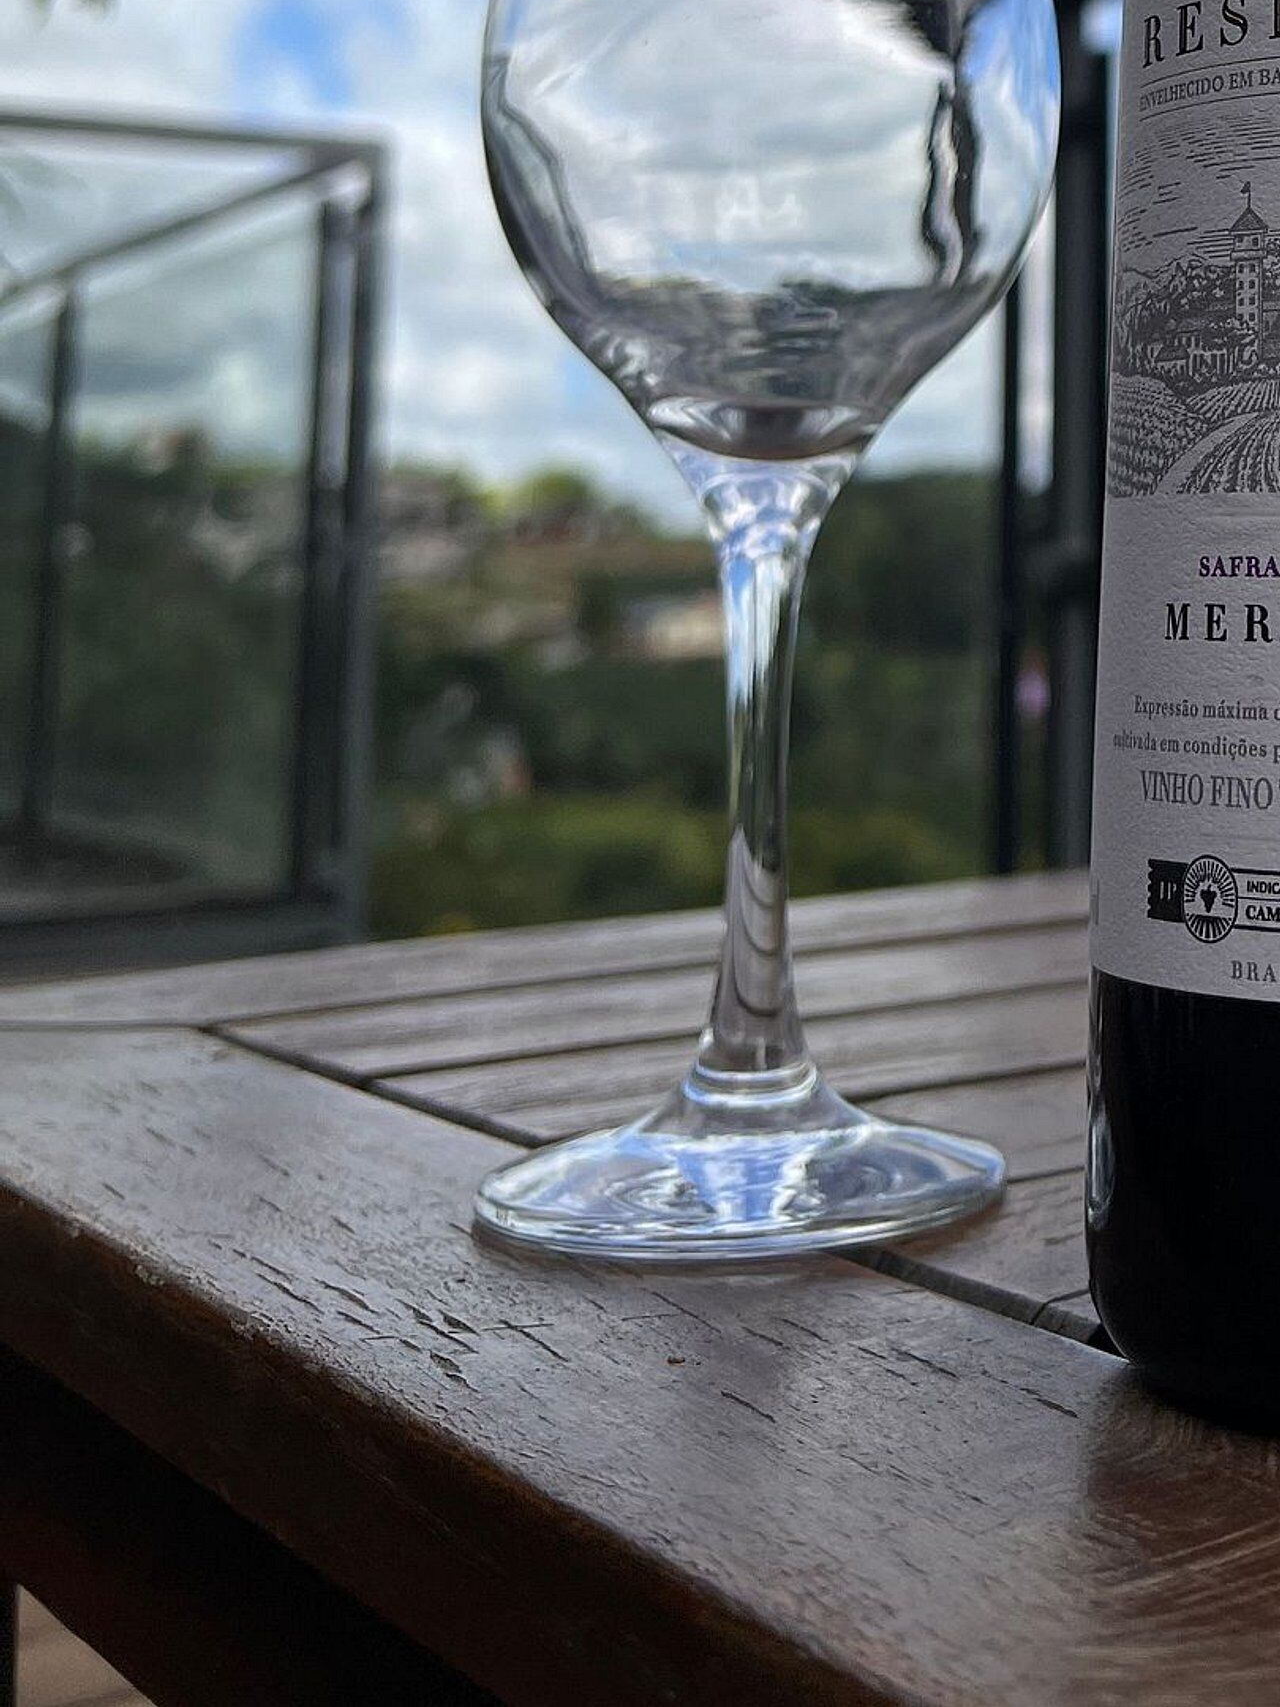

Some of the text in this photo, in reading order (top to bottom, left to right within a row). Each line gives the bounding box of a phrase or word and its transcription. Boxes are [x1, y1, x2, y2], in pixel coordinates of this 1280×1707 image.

[1138, 74, 1225, 112] ENVELHECIDO
[1229, 70, 1255, 90] EM
[1133, 694, 1199, 721] Expressão
[1201, 699, 1269, 722] máxima
[1159, 737, 1180, 754] em
[1183, 736, 1268, 761] condições
[1140, 769, 1205, 806] VINHO
[1209, 774, 1274, 810] FINO
